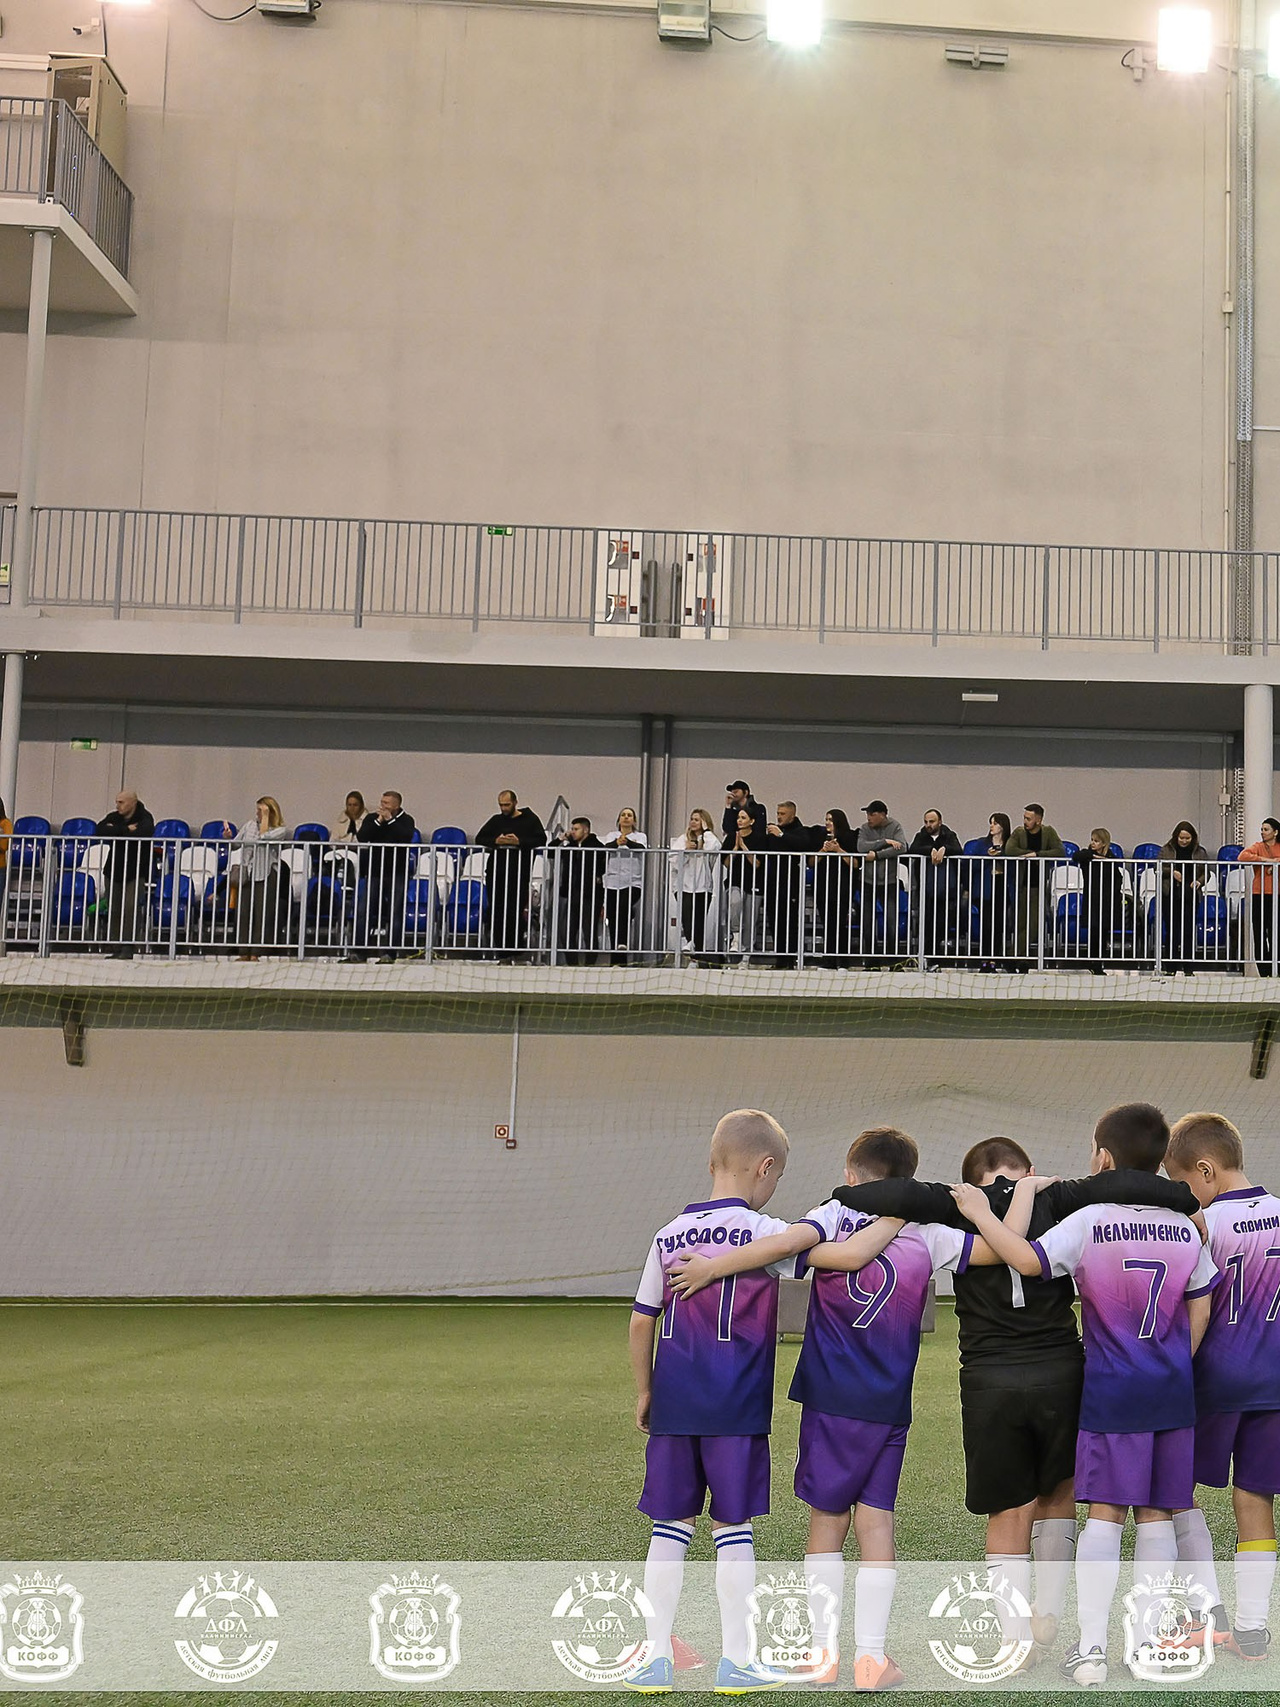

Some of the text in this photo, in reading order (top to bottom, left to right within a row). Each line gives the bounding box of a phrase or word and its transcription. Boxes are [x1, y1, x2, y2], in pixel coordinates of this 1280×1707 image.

[1092, 1222, 1192, 1244] МЕЛЬНИЧЕНКО
[845, 1251, 898, 1329] 9
[1122, 1258, 1168, 1339] 7
